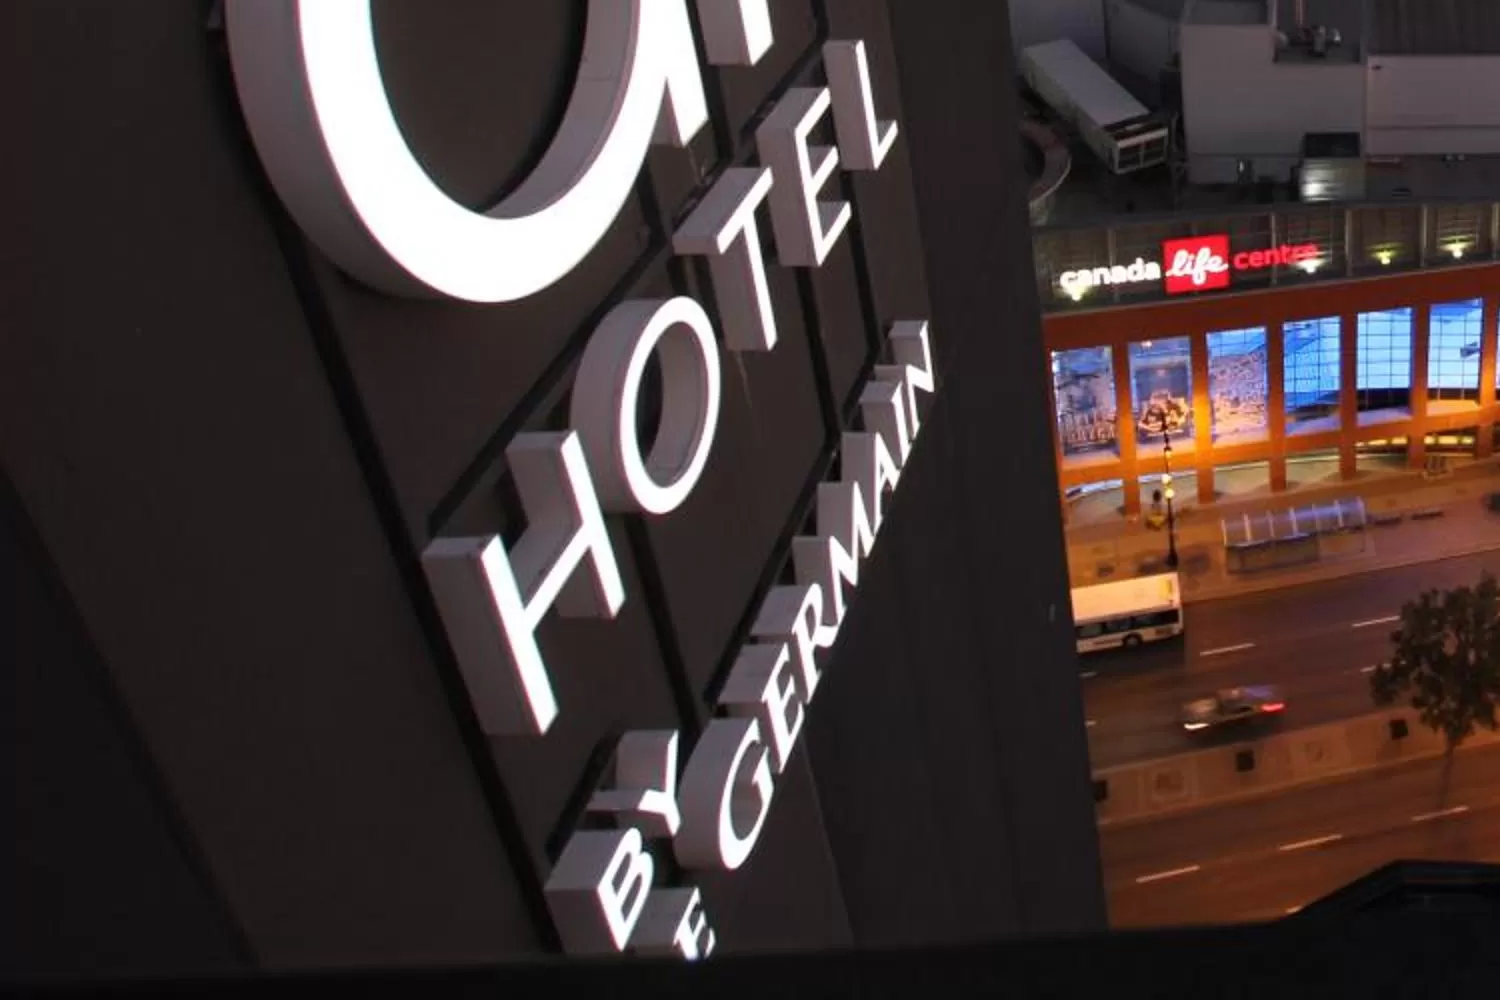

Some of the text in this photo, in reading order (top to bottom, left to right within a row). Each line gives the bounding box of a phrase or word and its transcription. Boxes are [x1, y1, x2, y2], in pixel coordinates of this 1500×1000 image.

[460, 40, 898, 732] HOTEL
[1059, 242, 1320, 290] canada life centre
[705, 319, 937, 869] GERMAIN
[578, 732, 682, 952] BY
